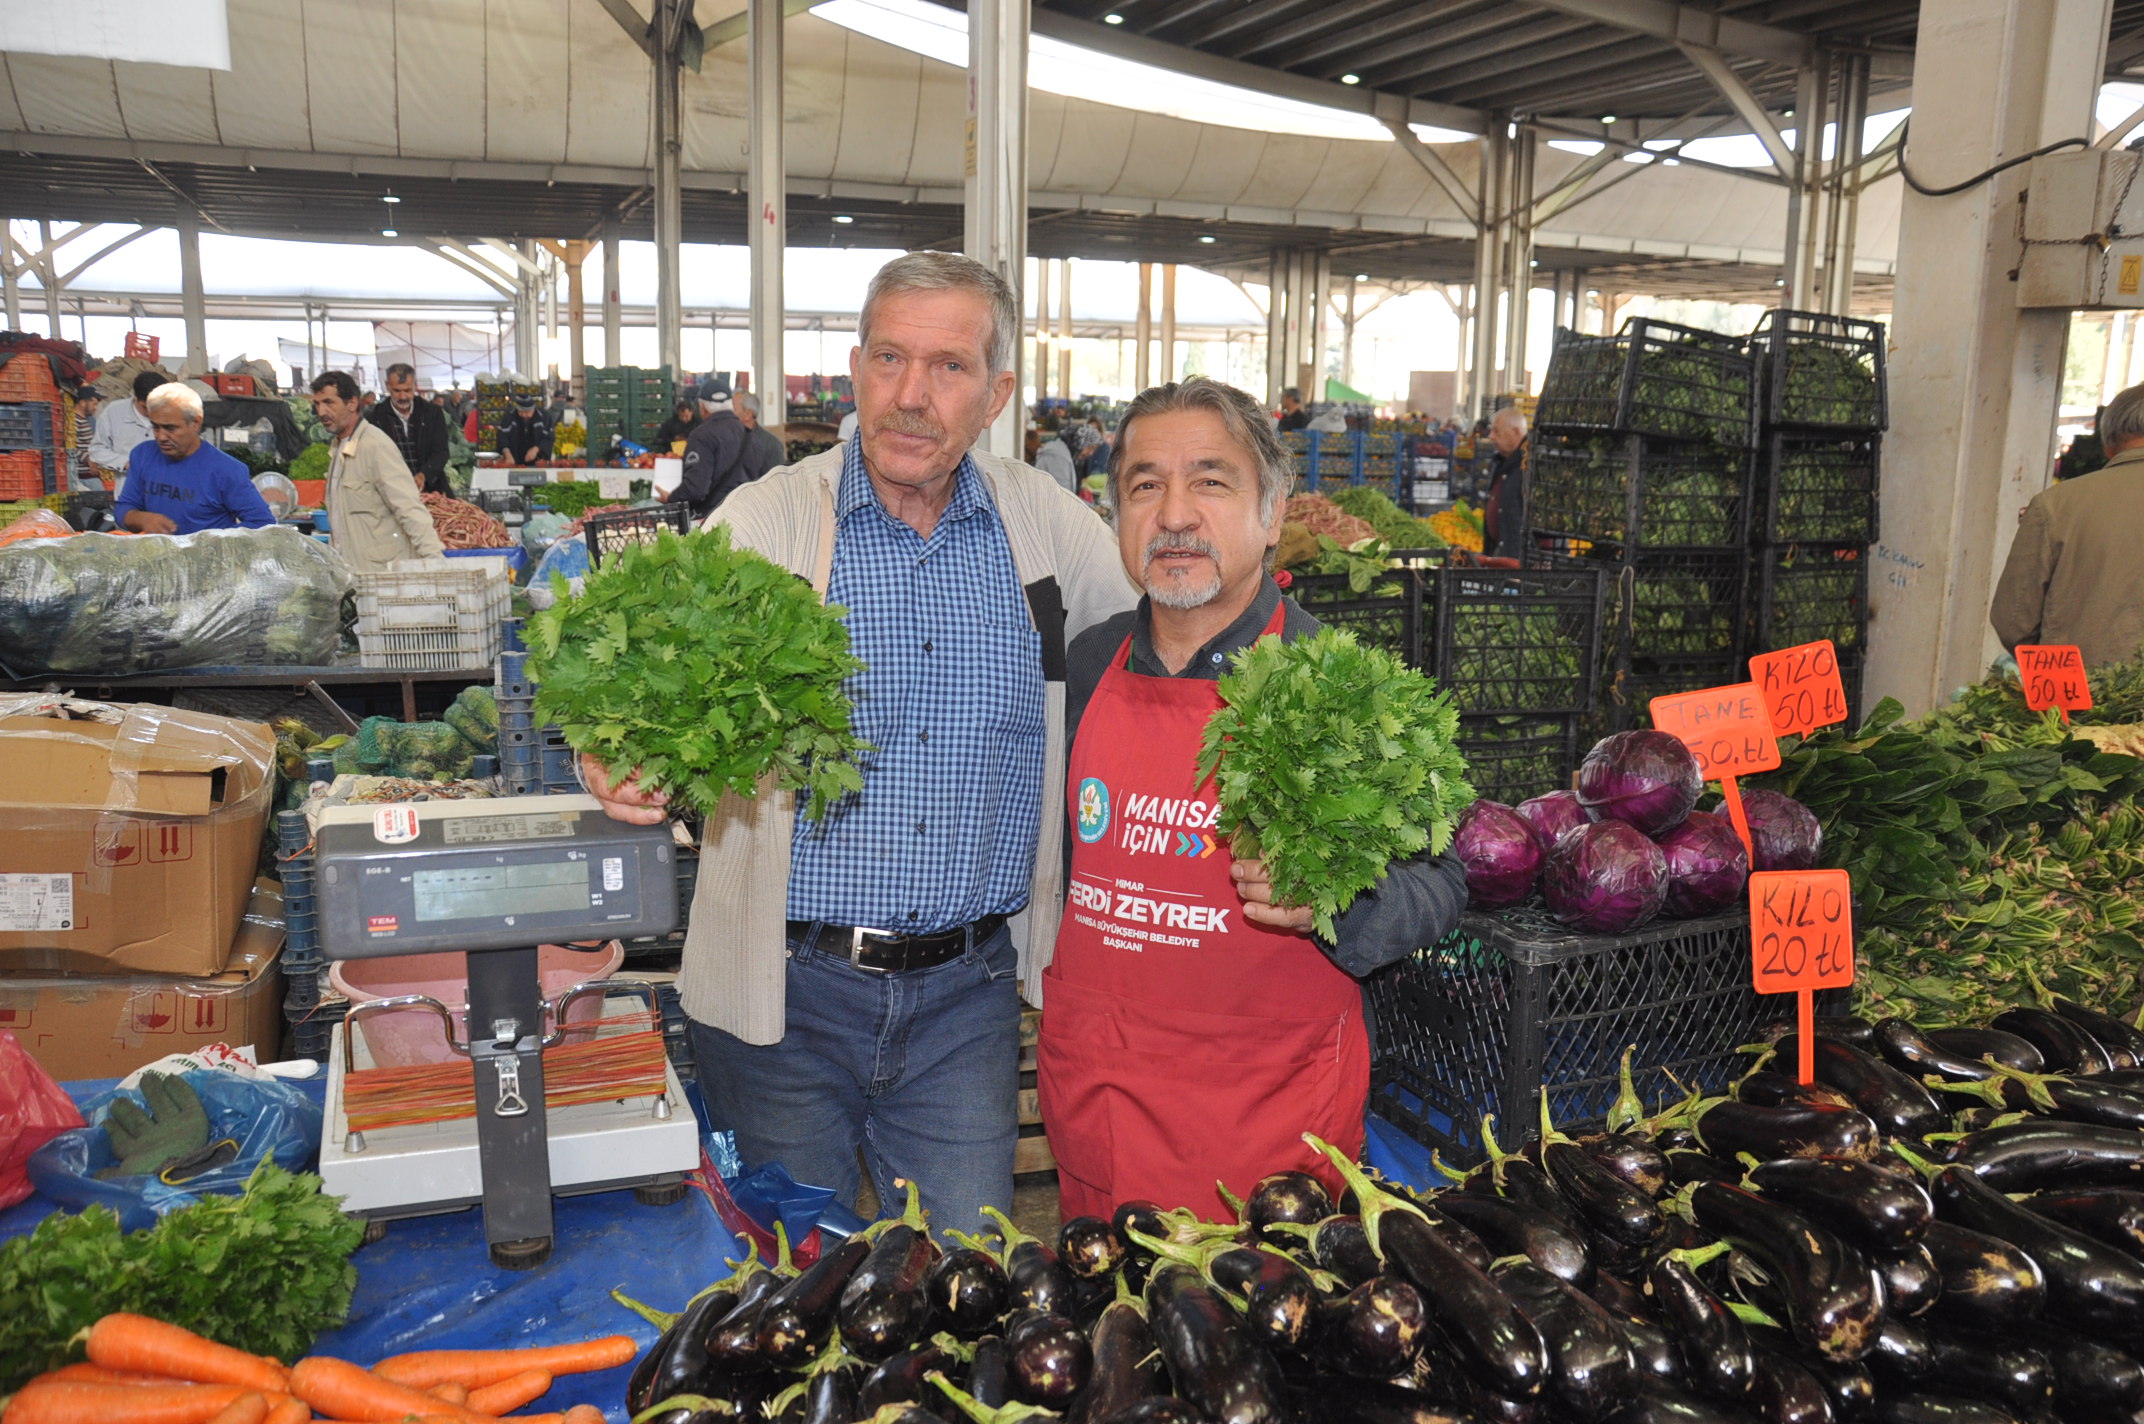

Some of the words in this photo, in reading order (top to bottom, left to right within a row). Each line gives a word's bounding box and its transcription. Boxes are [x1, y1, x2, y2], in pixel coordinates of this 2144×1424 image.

[2021, 650, 2077, 670] TANE
[2031, 675, 2055, 704] 50
[1660, 697, 1754, 729] TANE
[1774, 690, 1814, 729] 50
[1123, 793, 1222, 830] MANİSA
[1121, 822, 1171, 856] İÇİN
[370, 917, 396, 925] TEM
[1113, 893, 1231, 934] ZEYREK
[1103, 936, 1143, 952] BAŞKANI
[1761, 931, 1807, 977] 20
